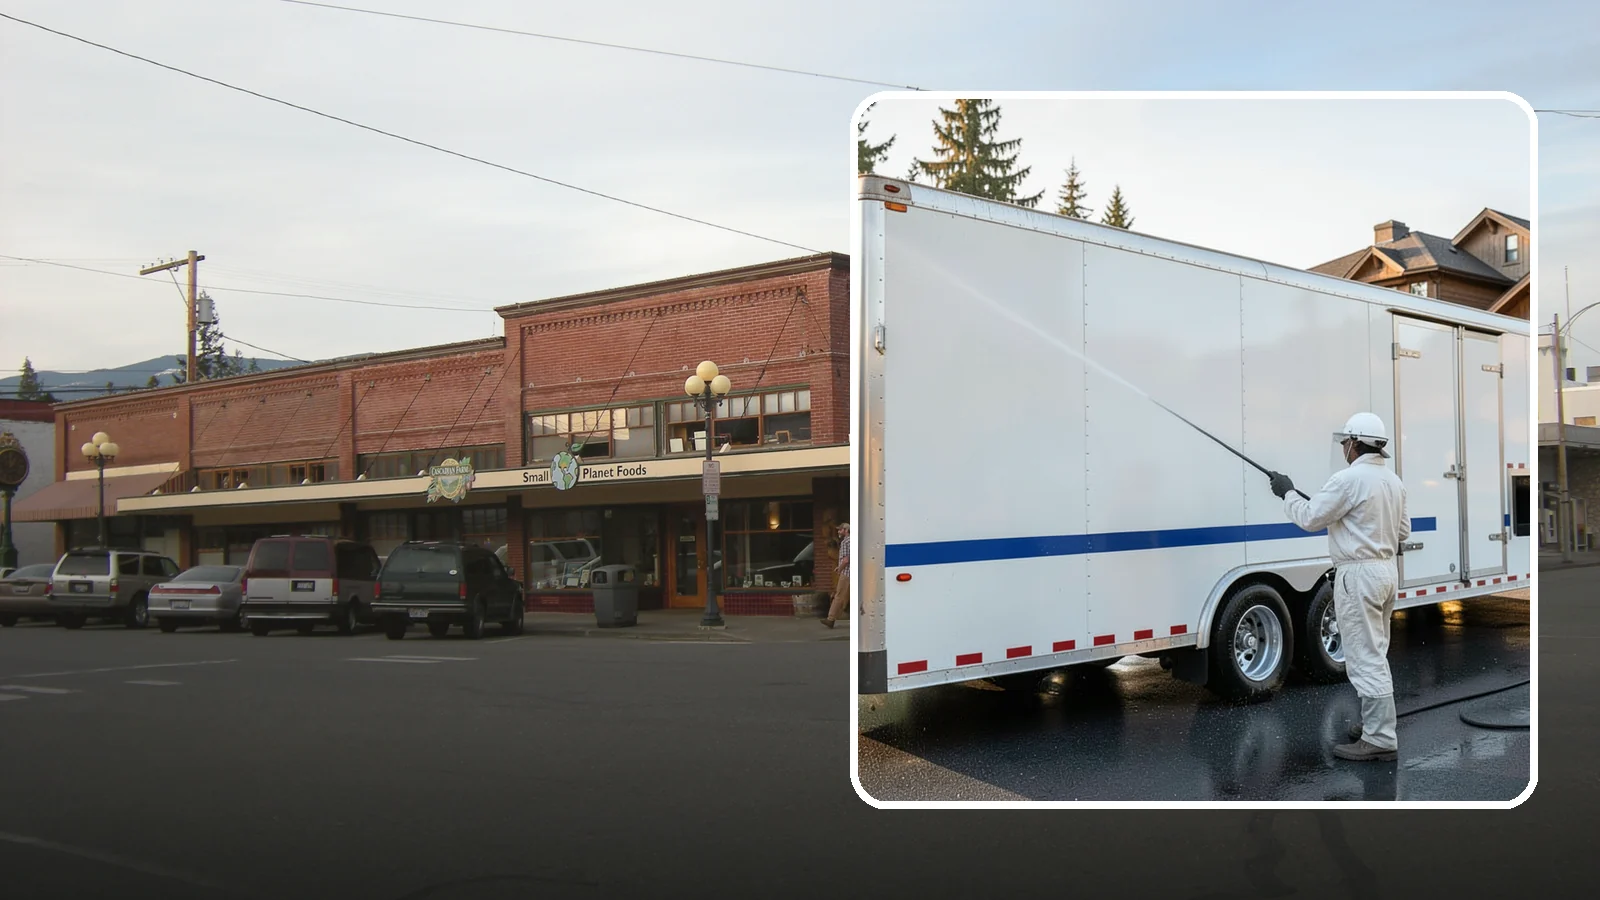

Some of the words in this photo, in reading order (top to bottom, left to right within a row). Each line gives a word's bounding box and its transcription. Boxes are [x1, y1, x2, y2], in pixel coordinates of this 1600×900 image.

[523, 471, 548, 483] Small
[583, 467, 614, 479] Planet
[617, 464, 647, 477] Foods
